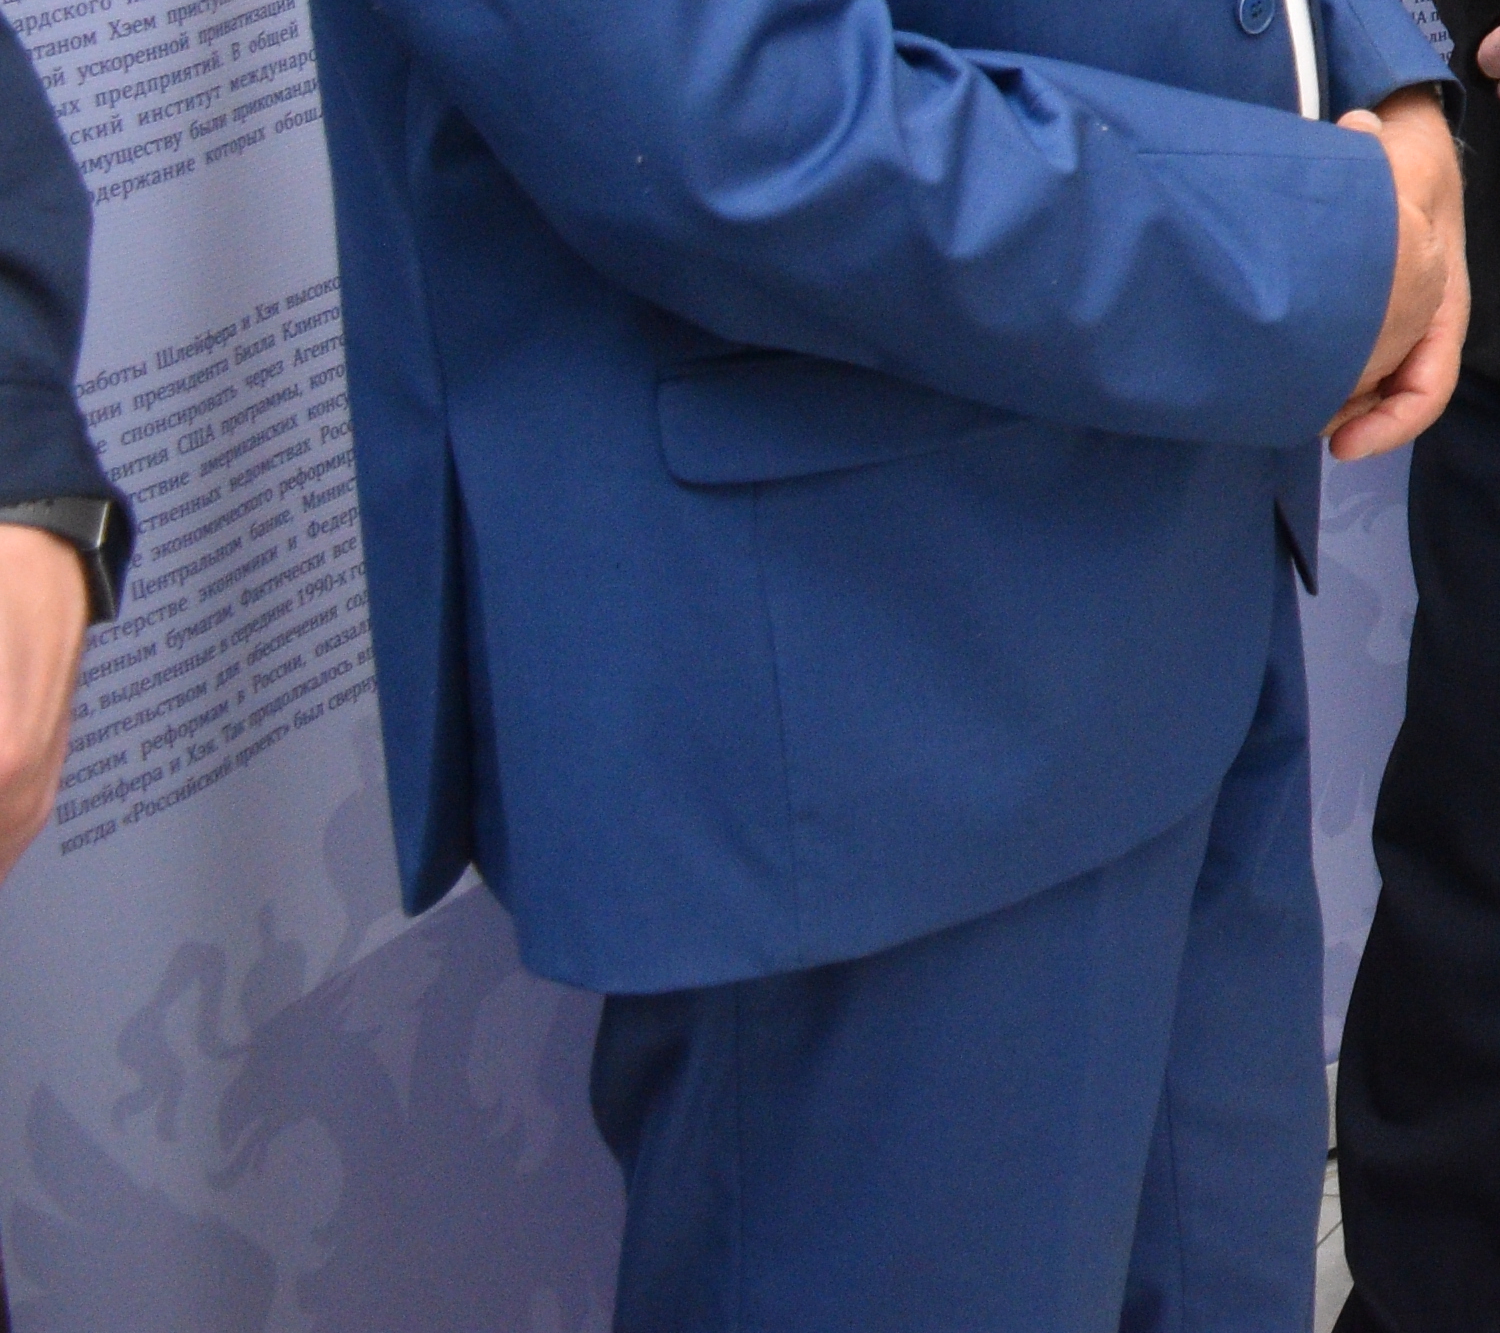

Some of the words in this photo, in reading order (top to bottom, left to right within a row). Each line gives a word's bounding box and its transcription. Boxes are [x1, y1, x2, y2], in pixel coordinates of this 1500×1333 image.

[133, 357, 230, 412] президента
[233, 335, 276, 367] Билла
[156, 321, 240, 371] Шлейфера
[120, 383, 238, 447] спонсировать
[177, 422, 217, 456] США
